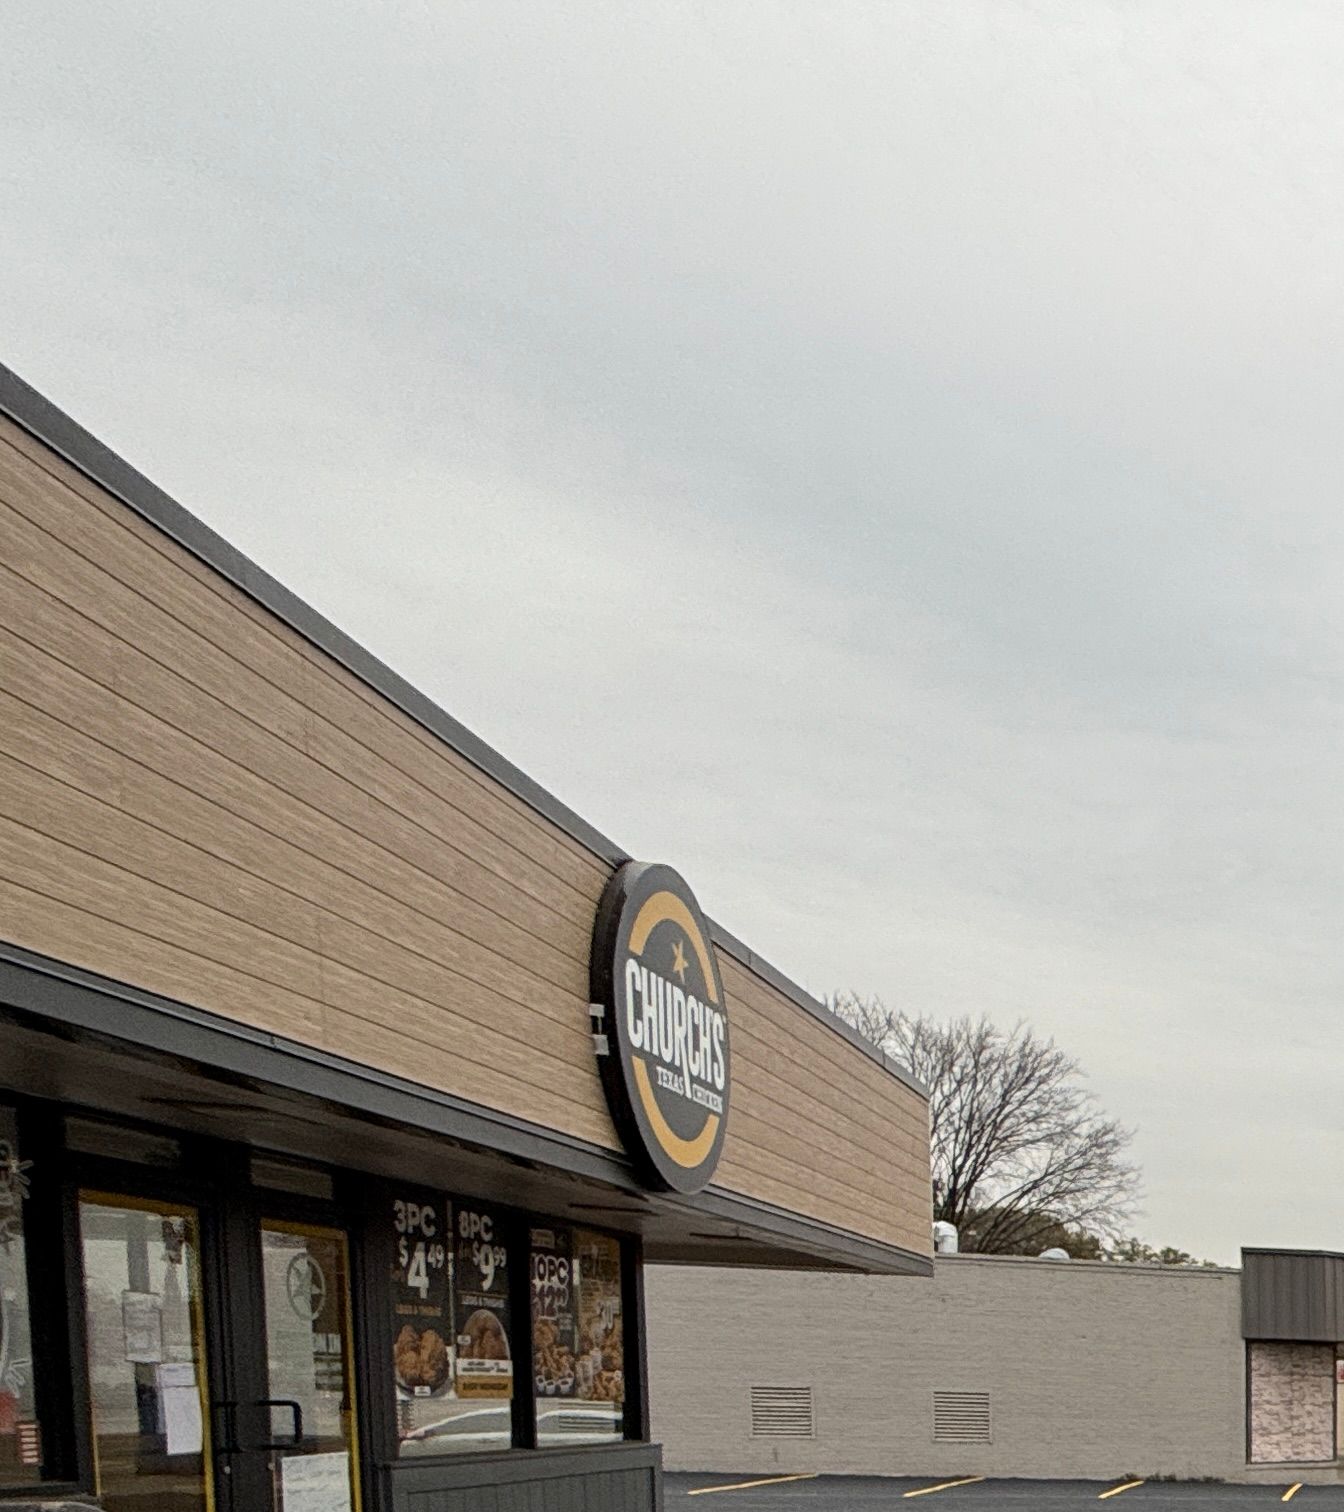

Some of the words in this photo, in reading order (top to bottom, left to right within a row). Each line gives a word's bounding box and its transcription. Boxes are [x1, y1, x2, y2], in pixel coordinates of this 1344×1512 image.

[626, 957, 726, 1099] CHURCH'S
[393, 1199, 437, 1238] 3PC
[458, 1210, 494, 1242] 8PC
